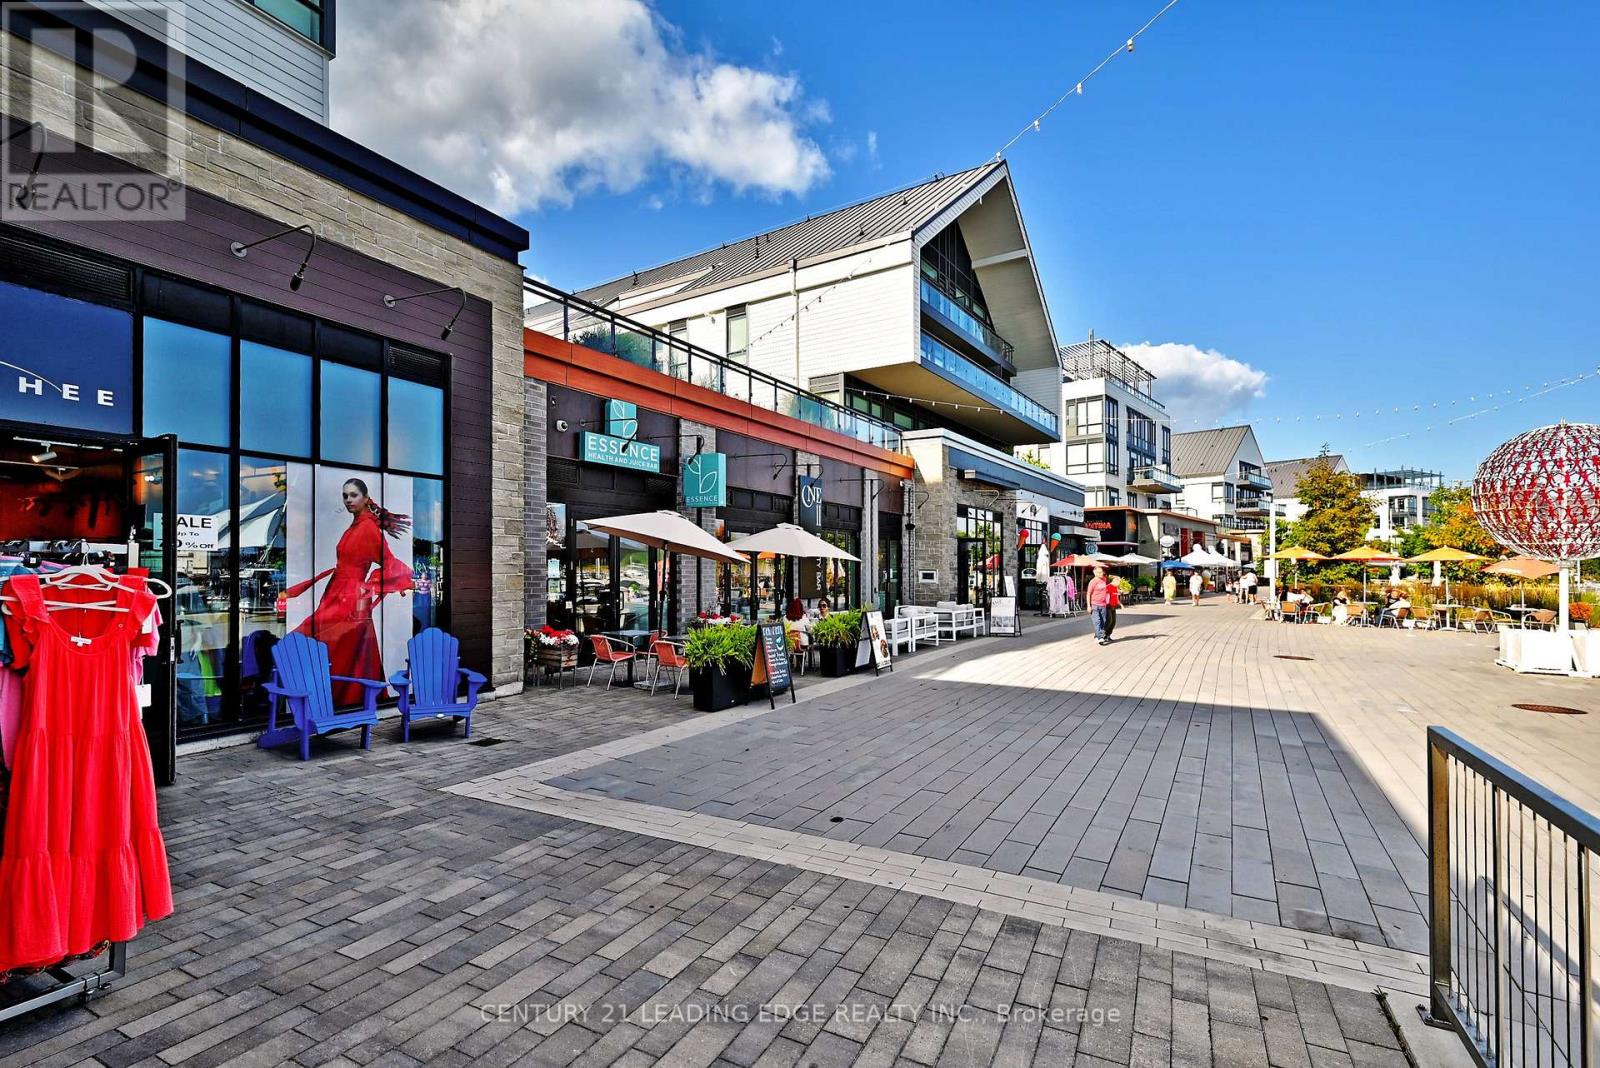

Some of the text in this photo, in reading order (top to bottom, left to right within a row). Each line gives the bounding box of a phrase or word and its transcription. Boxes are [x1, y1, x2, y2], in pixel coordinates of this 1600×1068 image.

[588, 435, 658, 461] ESSENCE
[588, 451, 614, 461] HEALTH
[614, 456, 628, 464] AND
[629, 459, 645, 467] JUICE
[686, 494, 718, 503] ESSENCE
[161, 516, 212, 528] ALE
